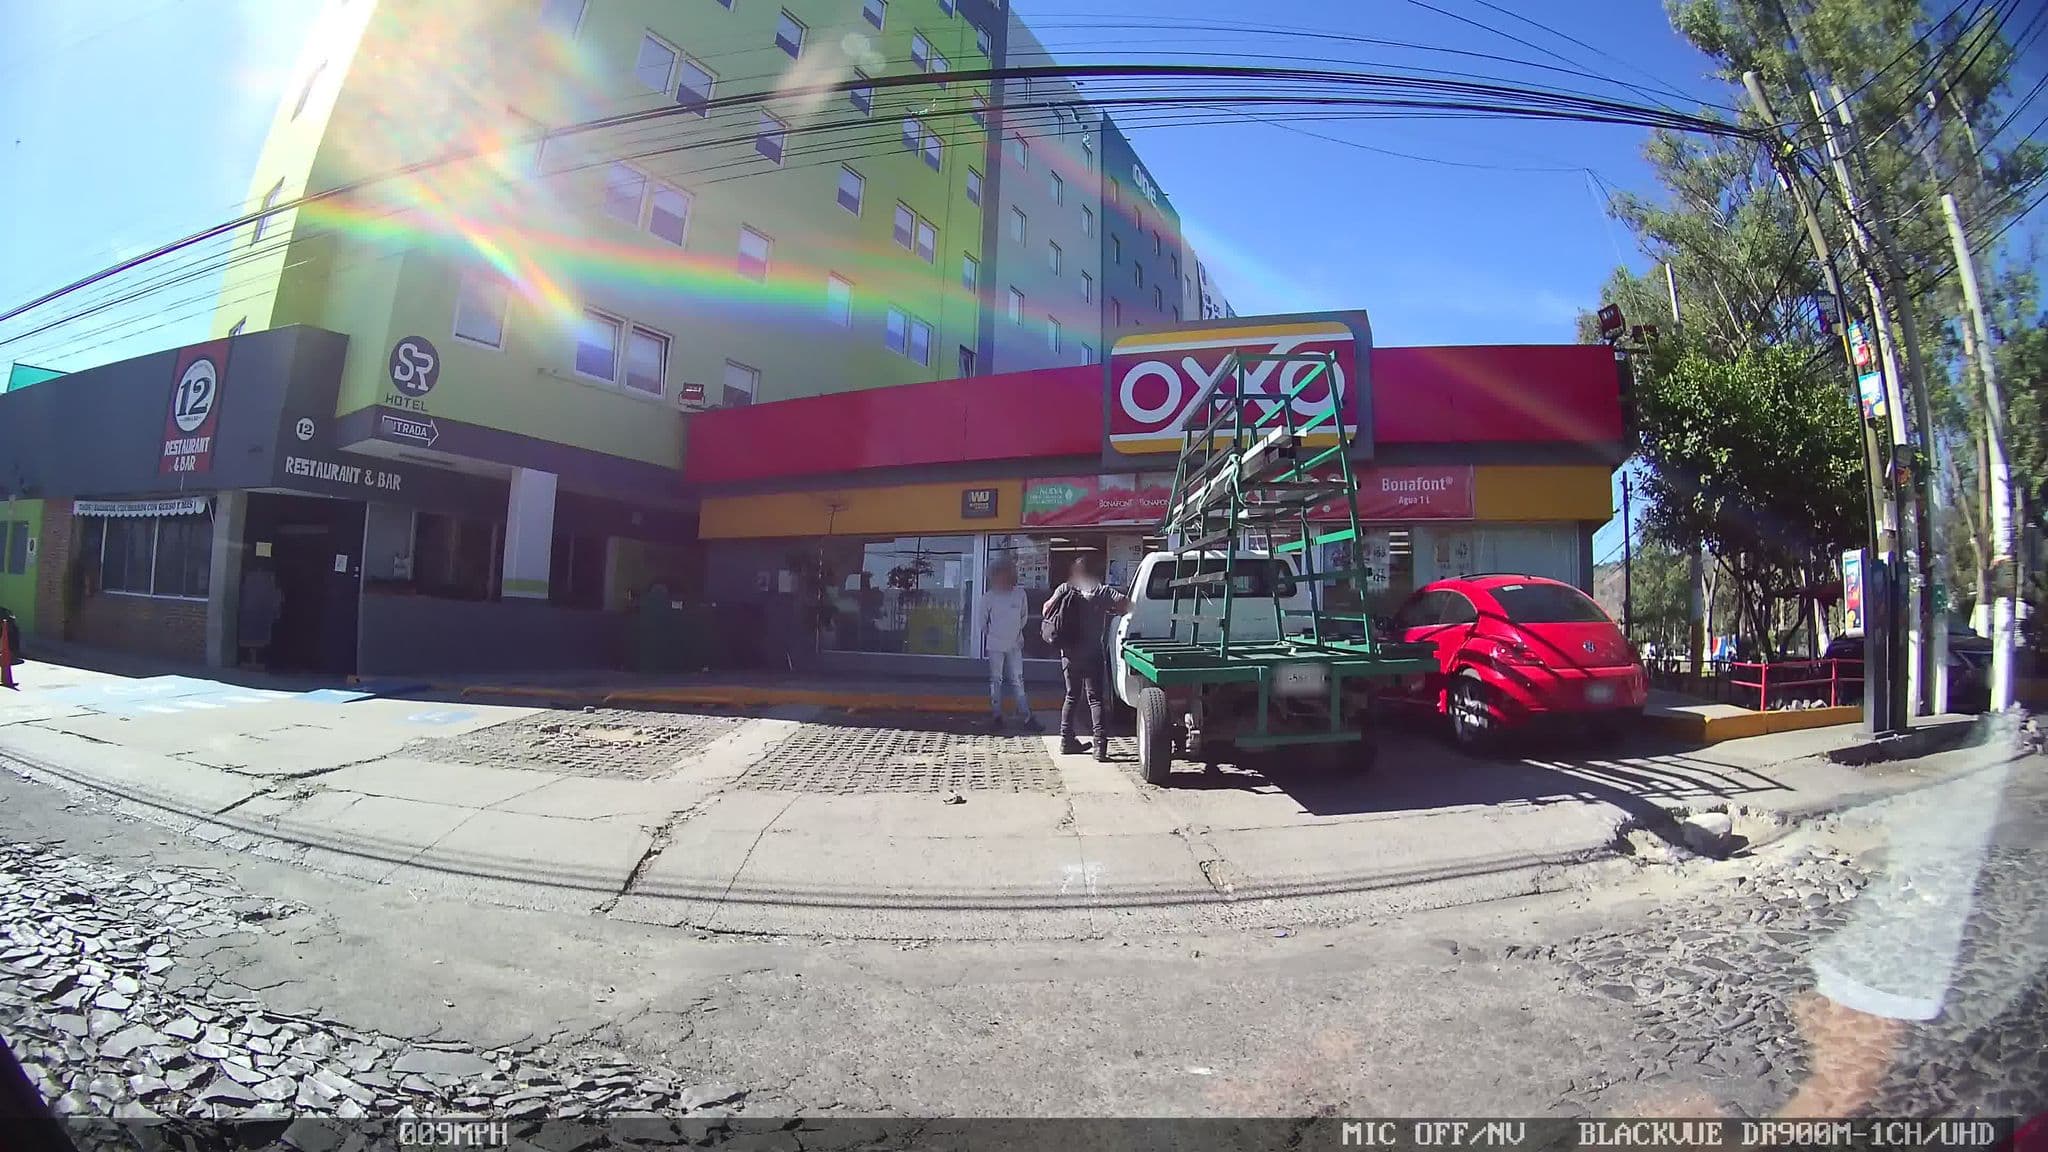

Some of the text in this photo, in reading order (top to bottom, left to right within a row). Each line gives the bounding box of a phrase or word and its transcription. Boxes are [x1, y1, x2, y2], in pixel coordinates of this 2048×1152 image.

[393, 342, 433, 391] SR
[176, 376, 211, 416] 12
[1119, 348, 1345, 426] OXXO
[384, 392, 428, 412] HOTEL
[298, 422, 313, 436] 12
[164, 437, 210, 457] RESTAURANT
[173, 455, 196, 472] & BAR
[285, 456, 402, 491] RESTAURANT & BAR
[1398, 496, 1417, 505] Agua
